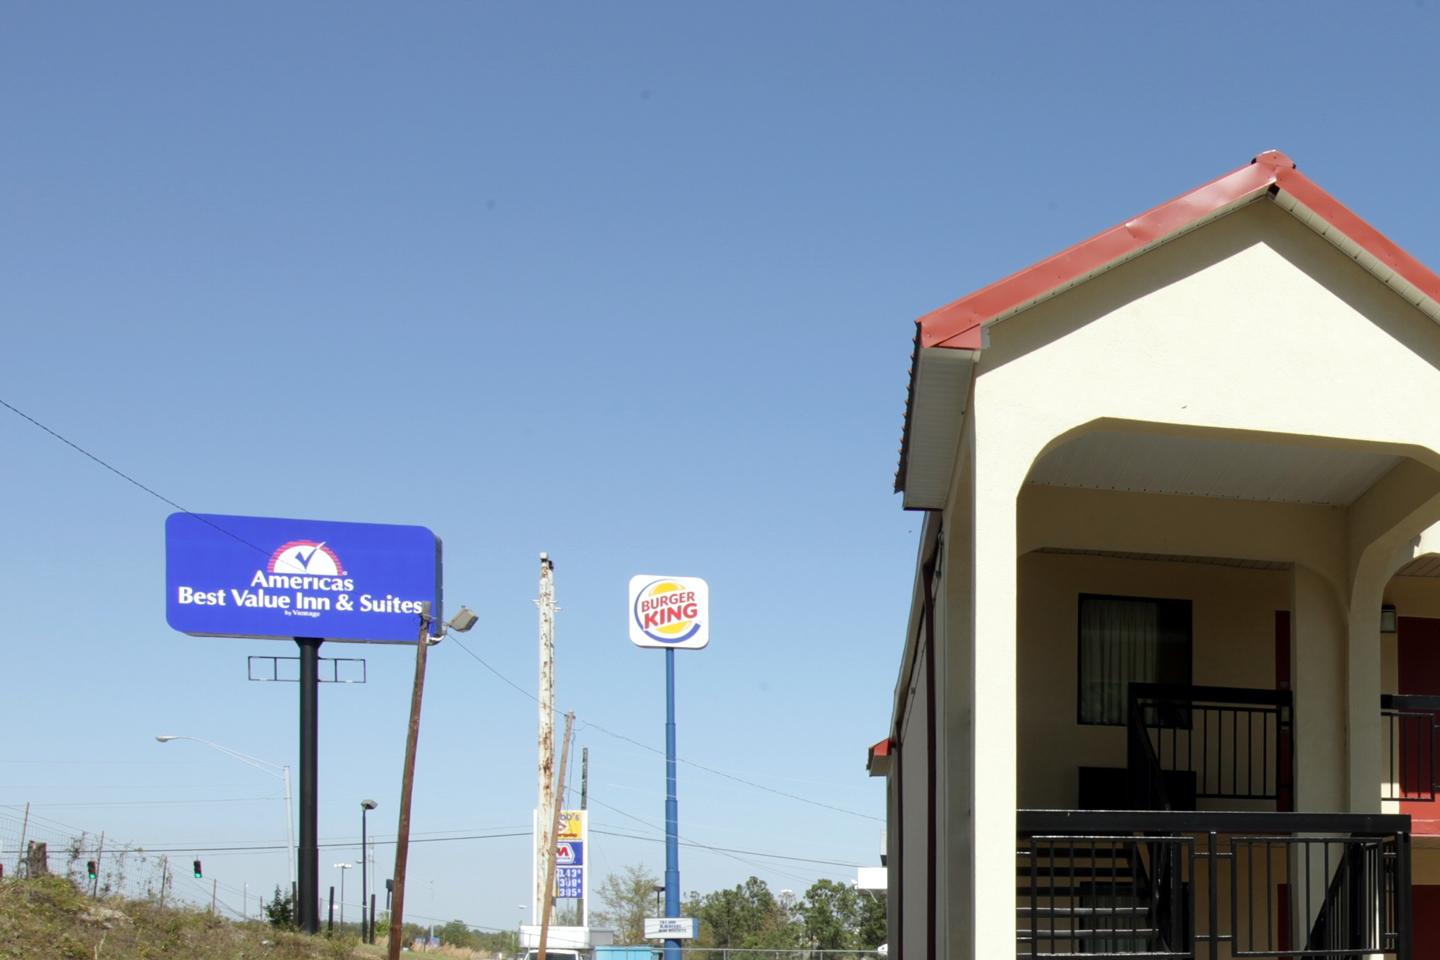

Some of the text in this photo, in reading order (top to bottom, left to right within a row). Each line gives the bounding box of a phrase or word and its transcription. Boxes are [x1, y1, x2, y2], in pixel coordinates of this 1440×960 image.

[251, 570, 354, 592] Americas
[178, 586, 423, 614] Best Value Inn & Suites
[641, 591, 695, 613] BURGER
[644, 602, 698, 630] KING
